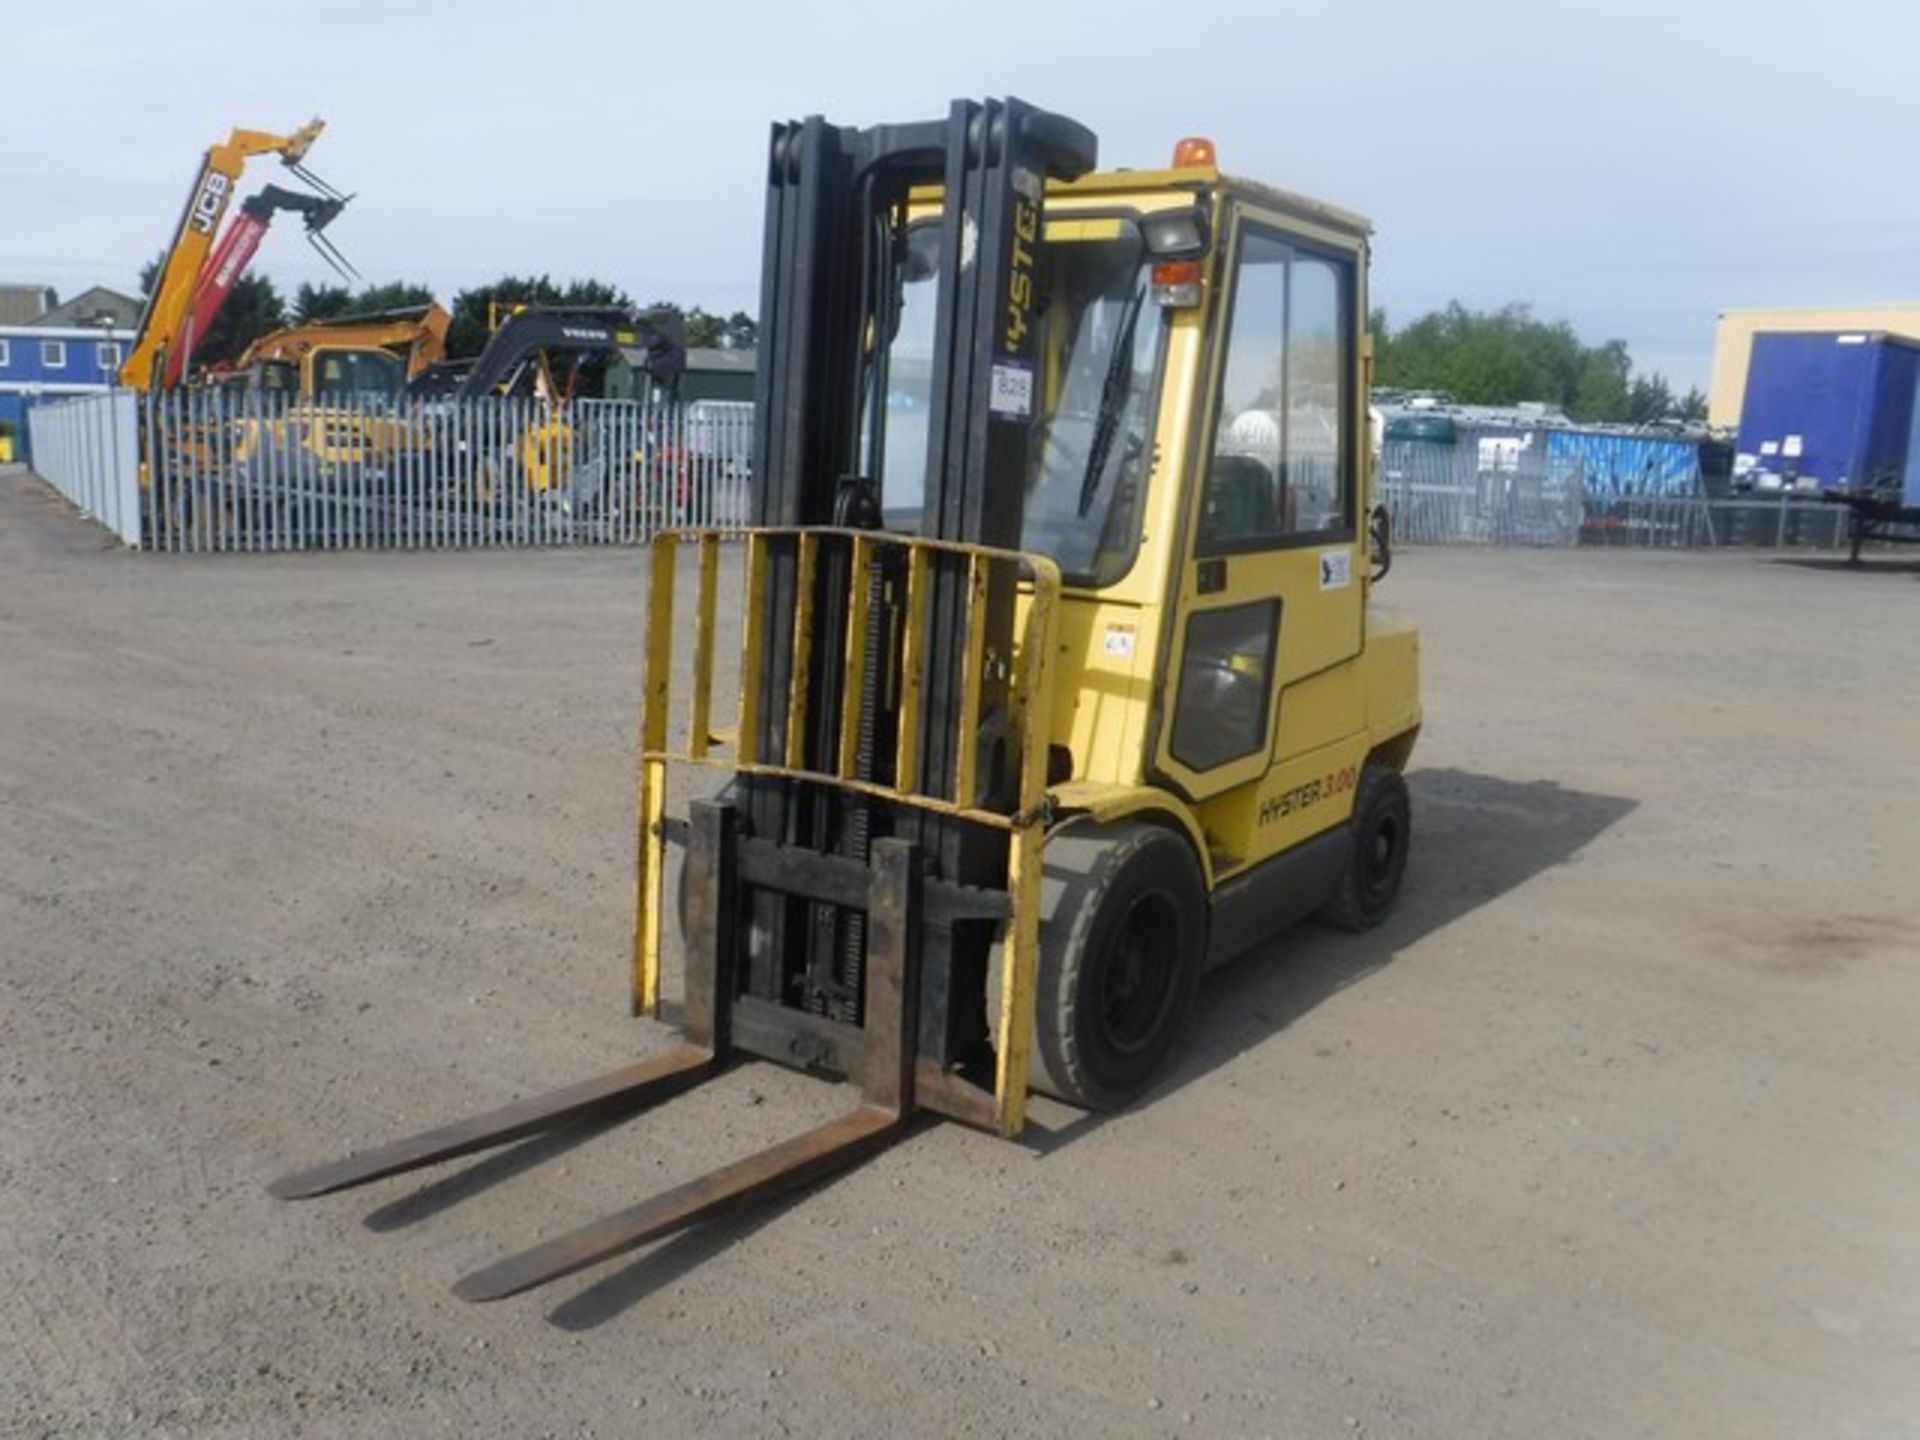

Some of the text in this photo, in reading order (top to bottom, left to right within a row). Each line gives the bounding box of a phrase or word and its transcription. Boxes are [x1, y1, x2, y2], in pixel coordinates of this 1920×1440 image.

[194, 173, 228, 233] JCB
[1006, 200, 1037, 352] YSTE
[1258, 779, 1320, 828] HYSTER
